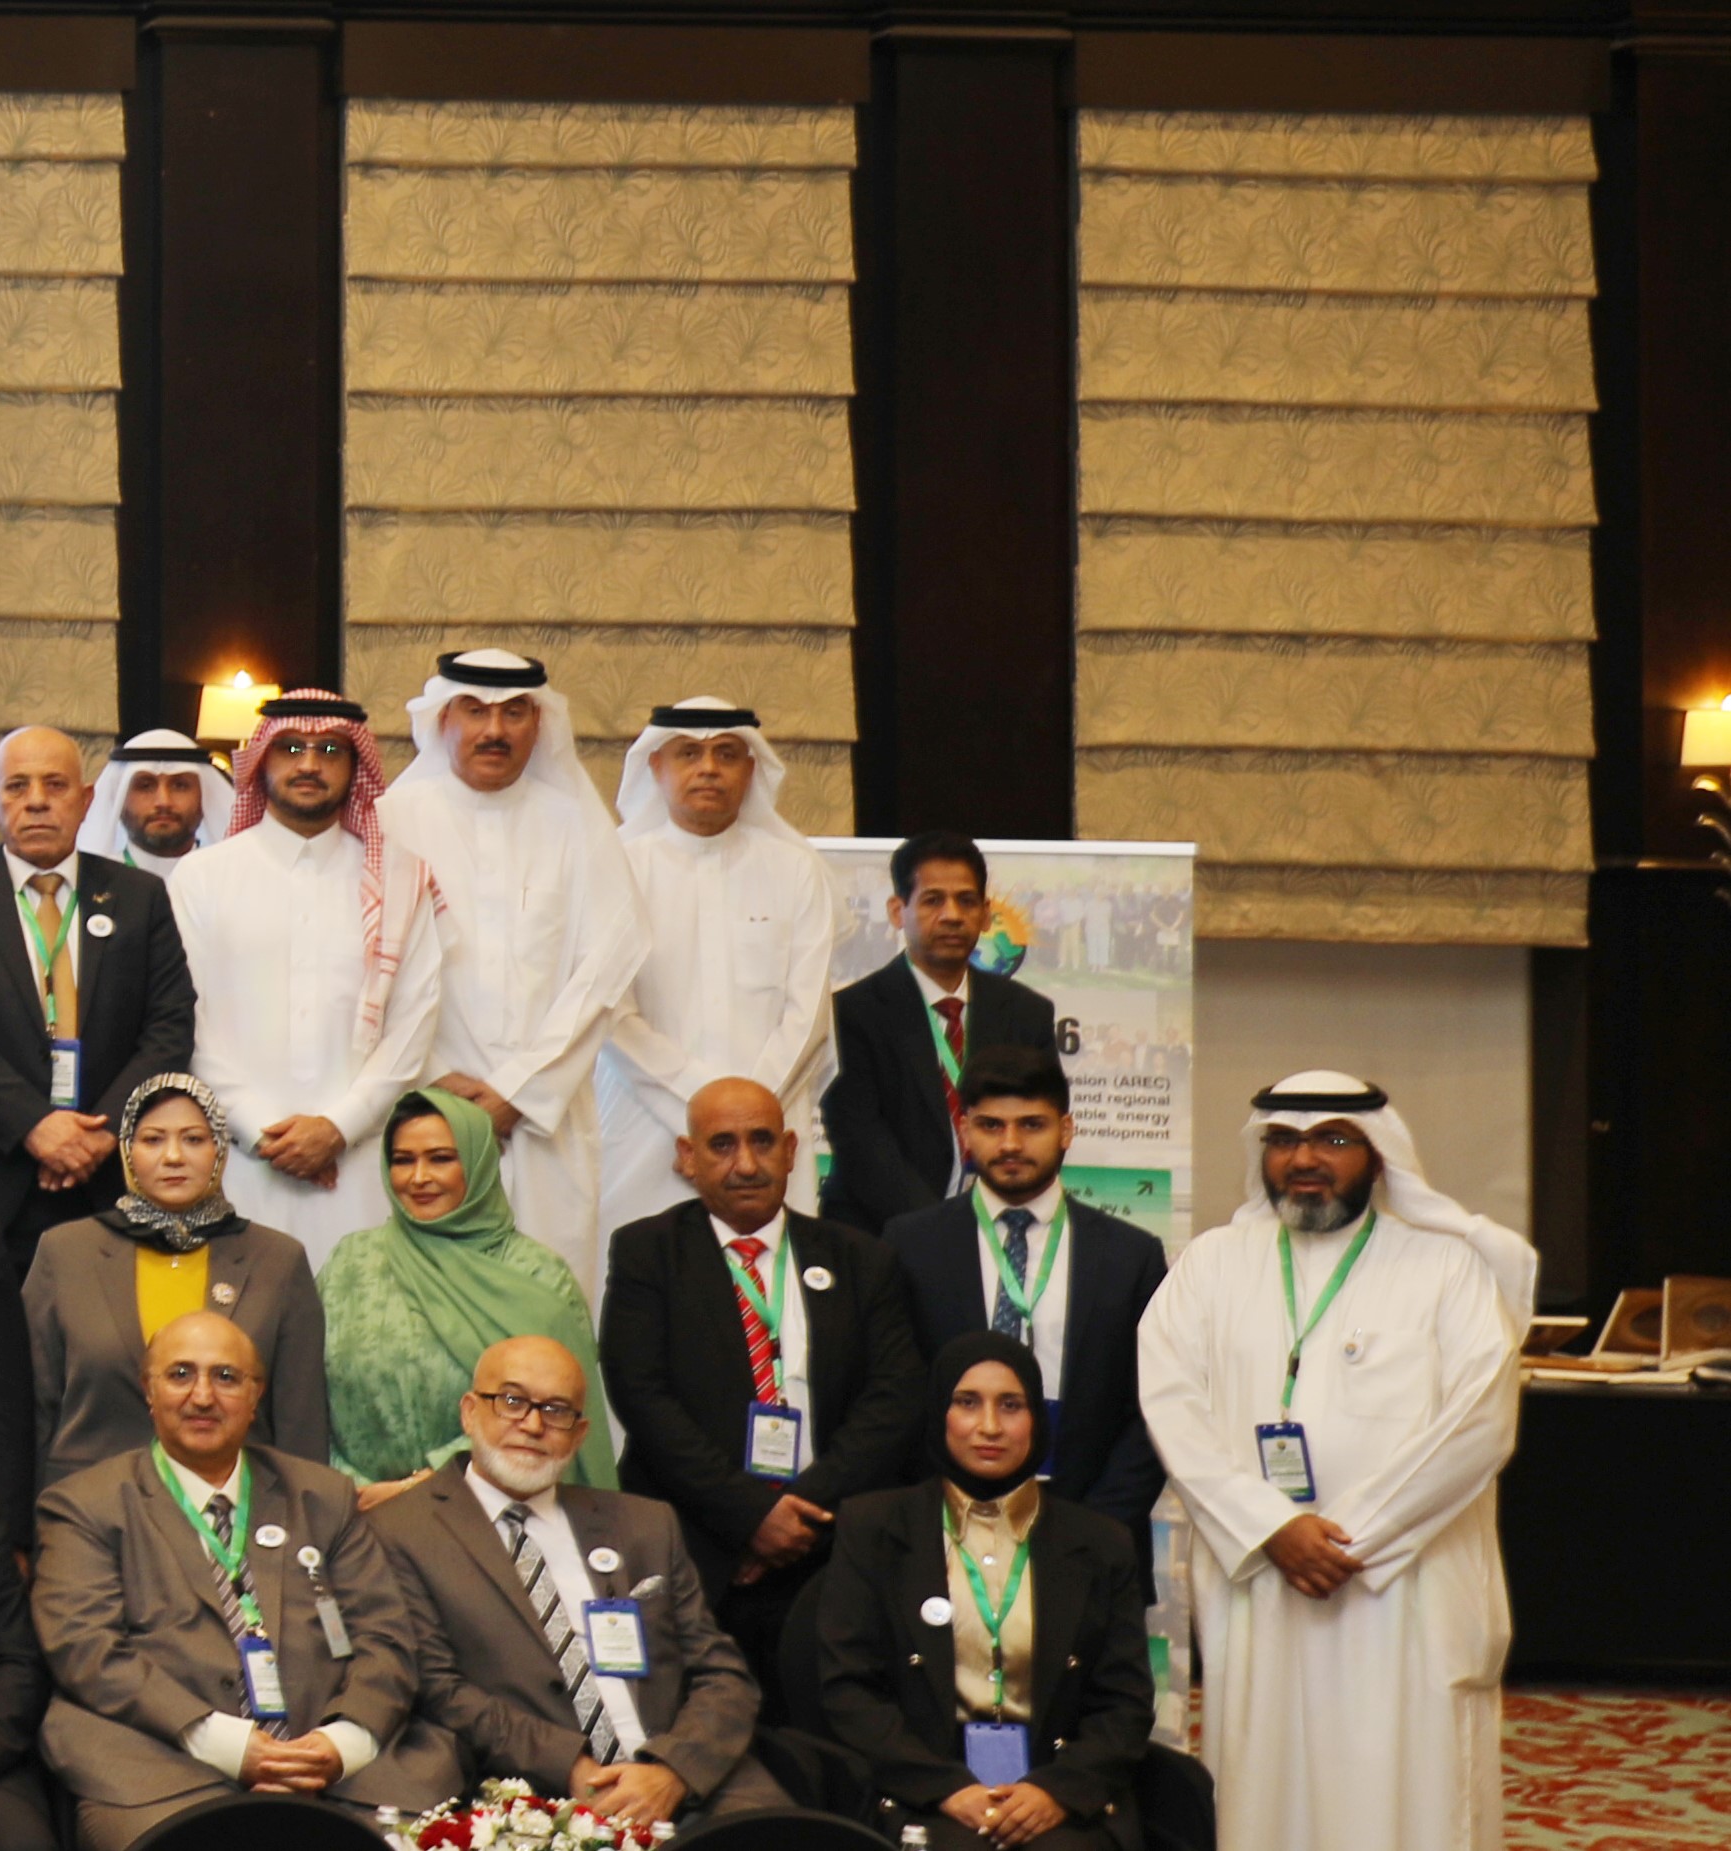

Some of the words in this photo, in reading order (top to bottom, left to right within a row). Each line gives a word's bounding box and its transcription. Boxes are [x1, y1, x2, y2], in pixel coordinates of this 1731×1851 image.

[1074, 1092, 1102, 1103] and
[1107, 1094, 1170, 1107] regional
[1116, 1111, 1170, 1125] energy
